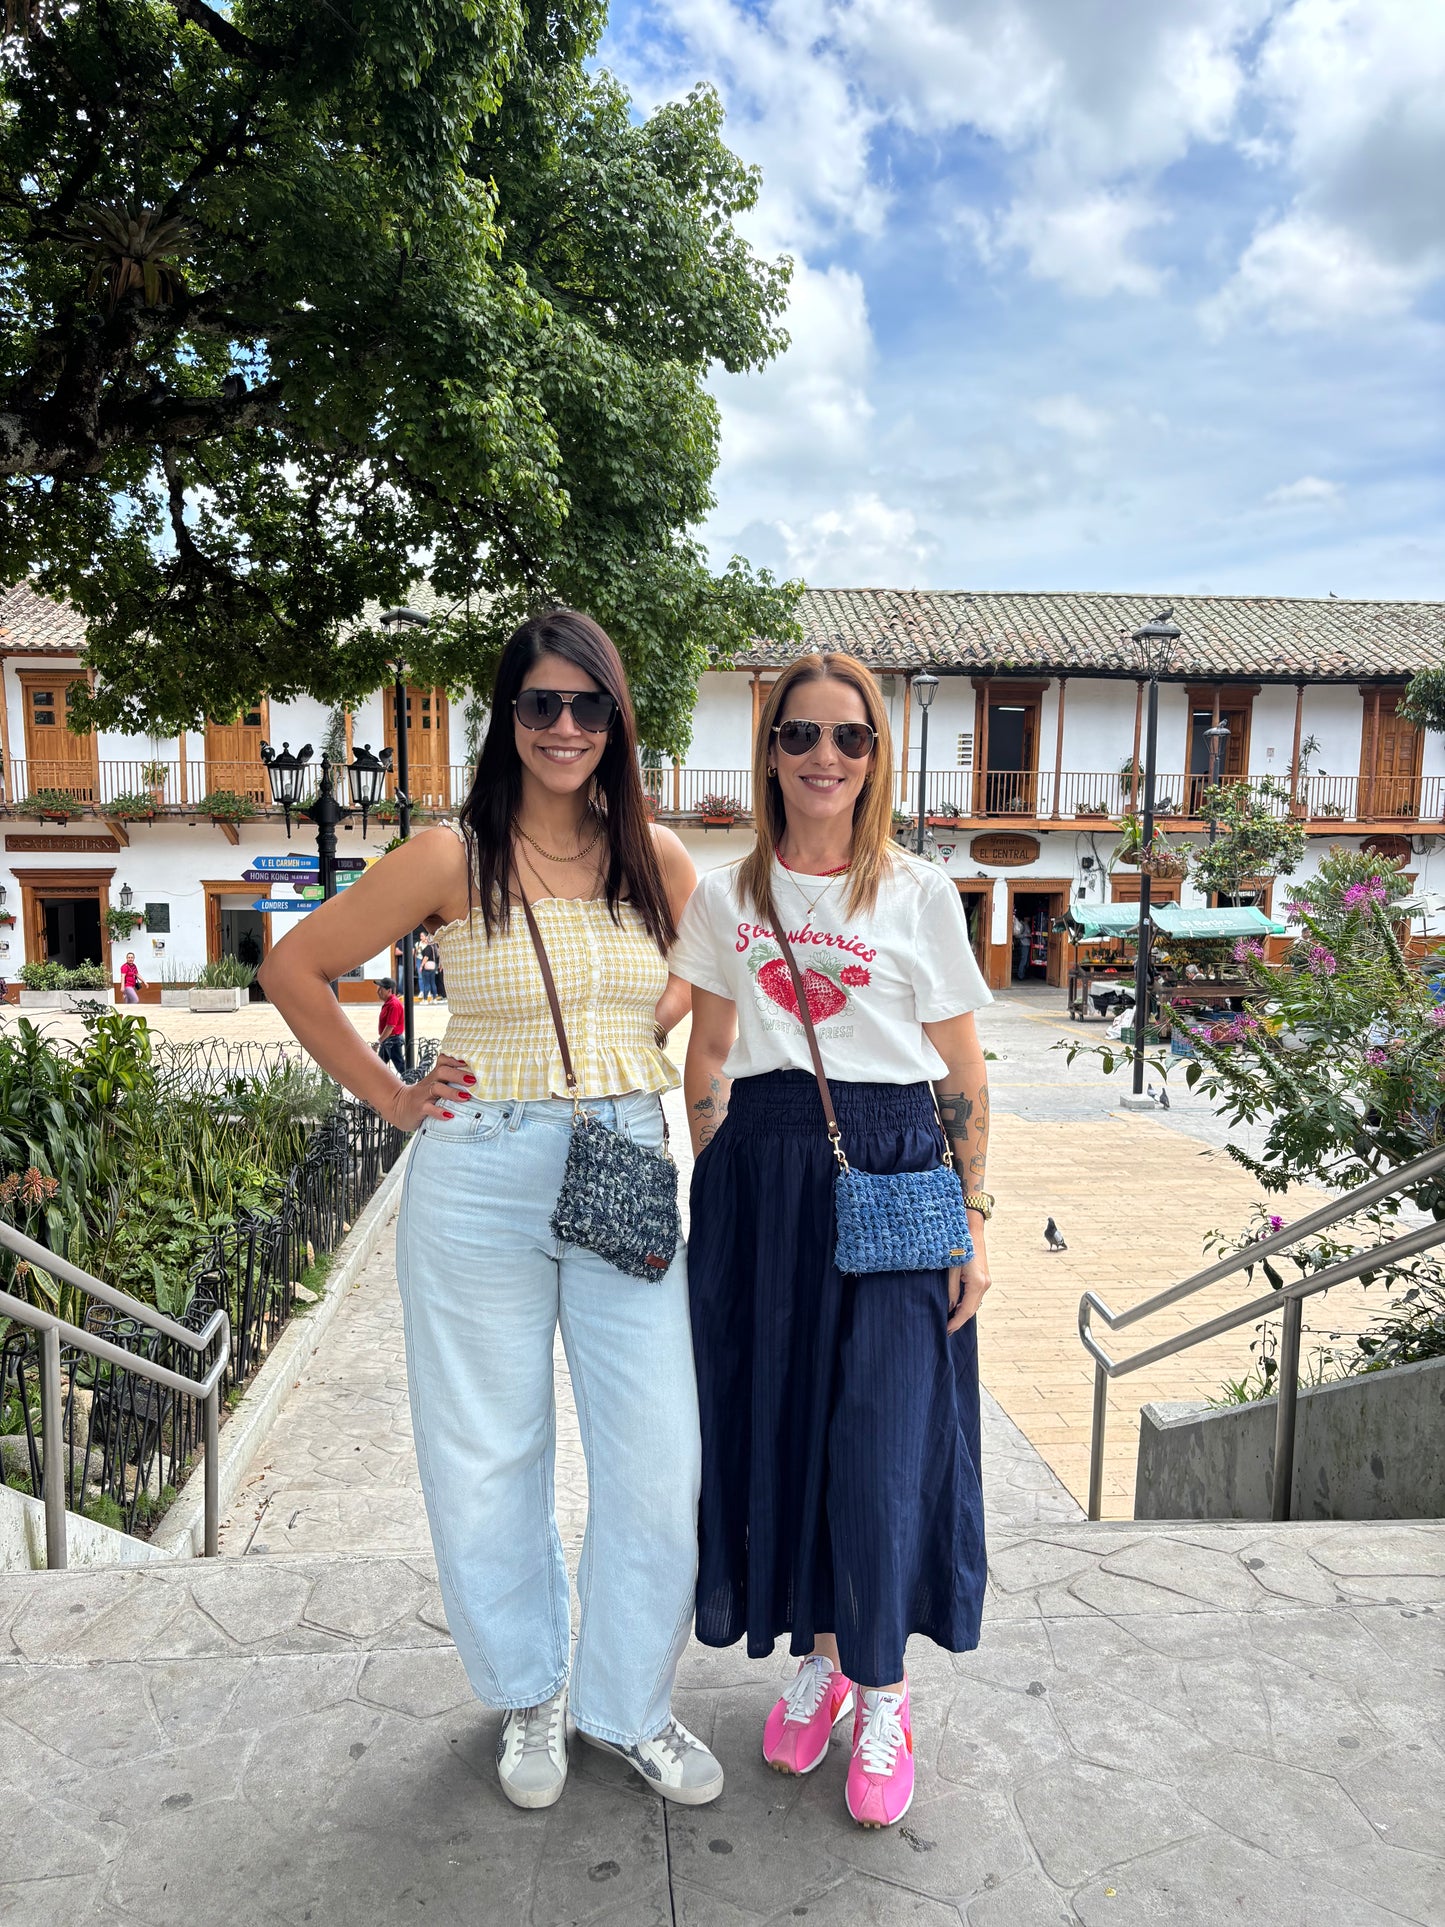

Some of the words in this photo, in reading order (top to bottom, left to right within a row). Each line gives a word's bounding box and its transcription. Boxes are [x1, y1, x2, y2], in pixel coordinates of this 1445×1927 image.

[979, 848, 989, 859] EL
[992, 848, 1030, 860] CENTRAL
[268, 859, 275, 867] EL
[275, 859, 300, 867] CARMEN
[250, 872, 269, 881] HONG
[270, 873, 289, 881] KONG
[261, 901, 289, 910] LONDRES
[818, 1025, 854, 1040] FRESH
